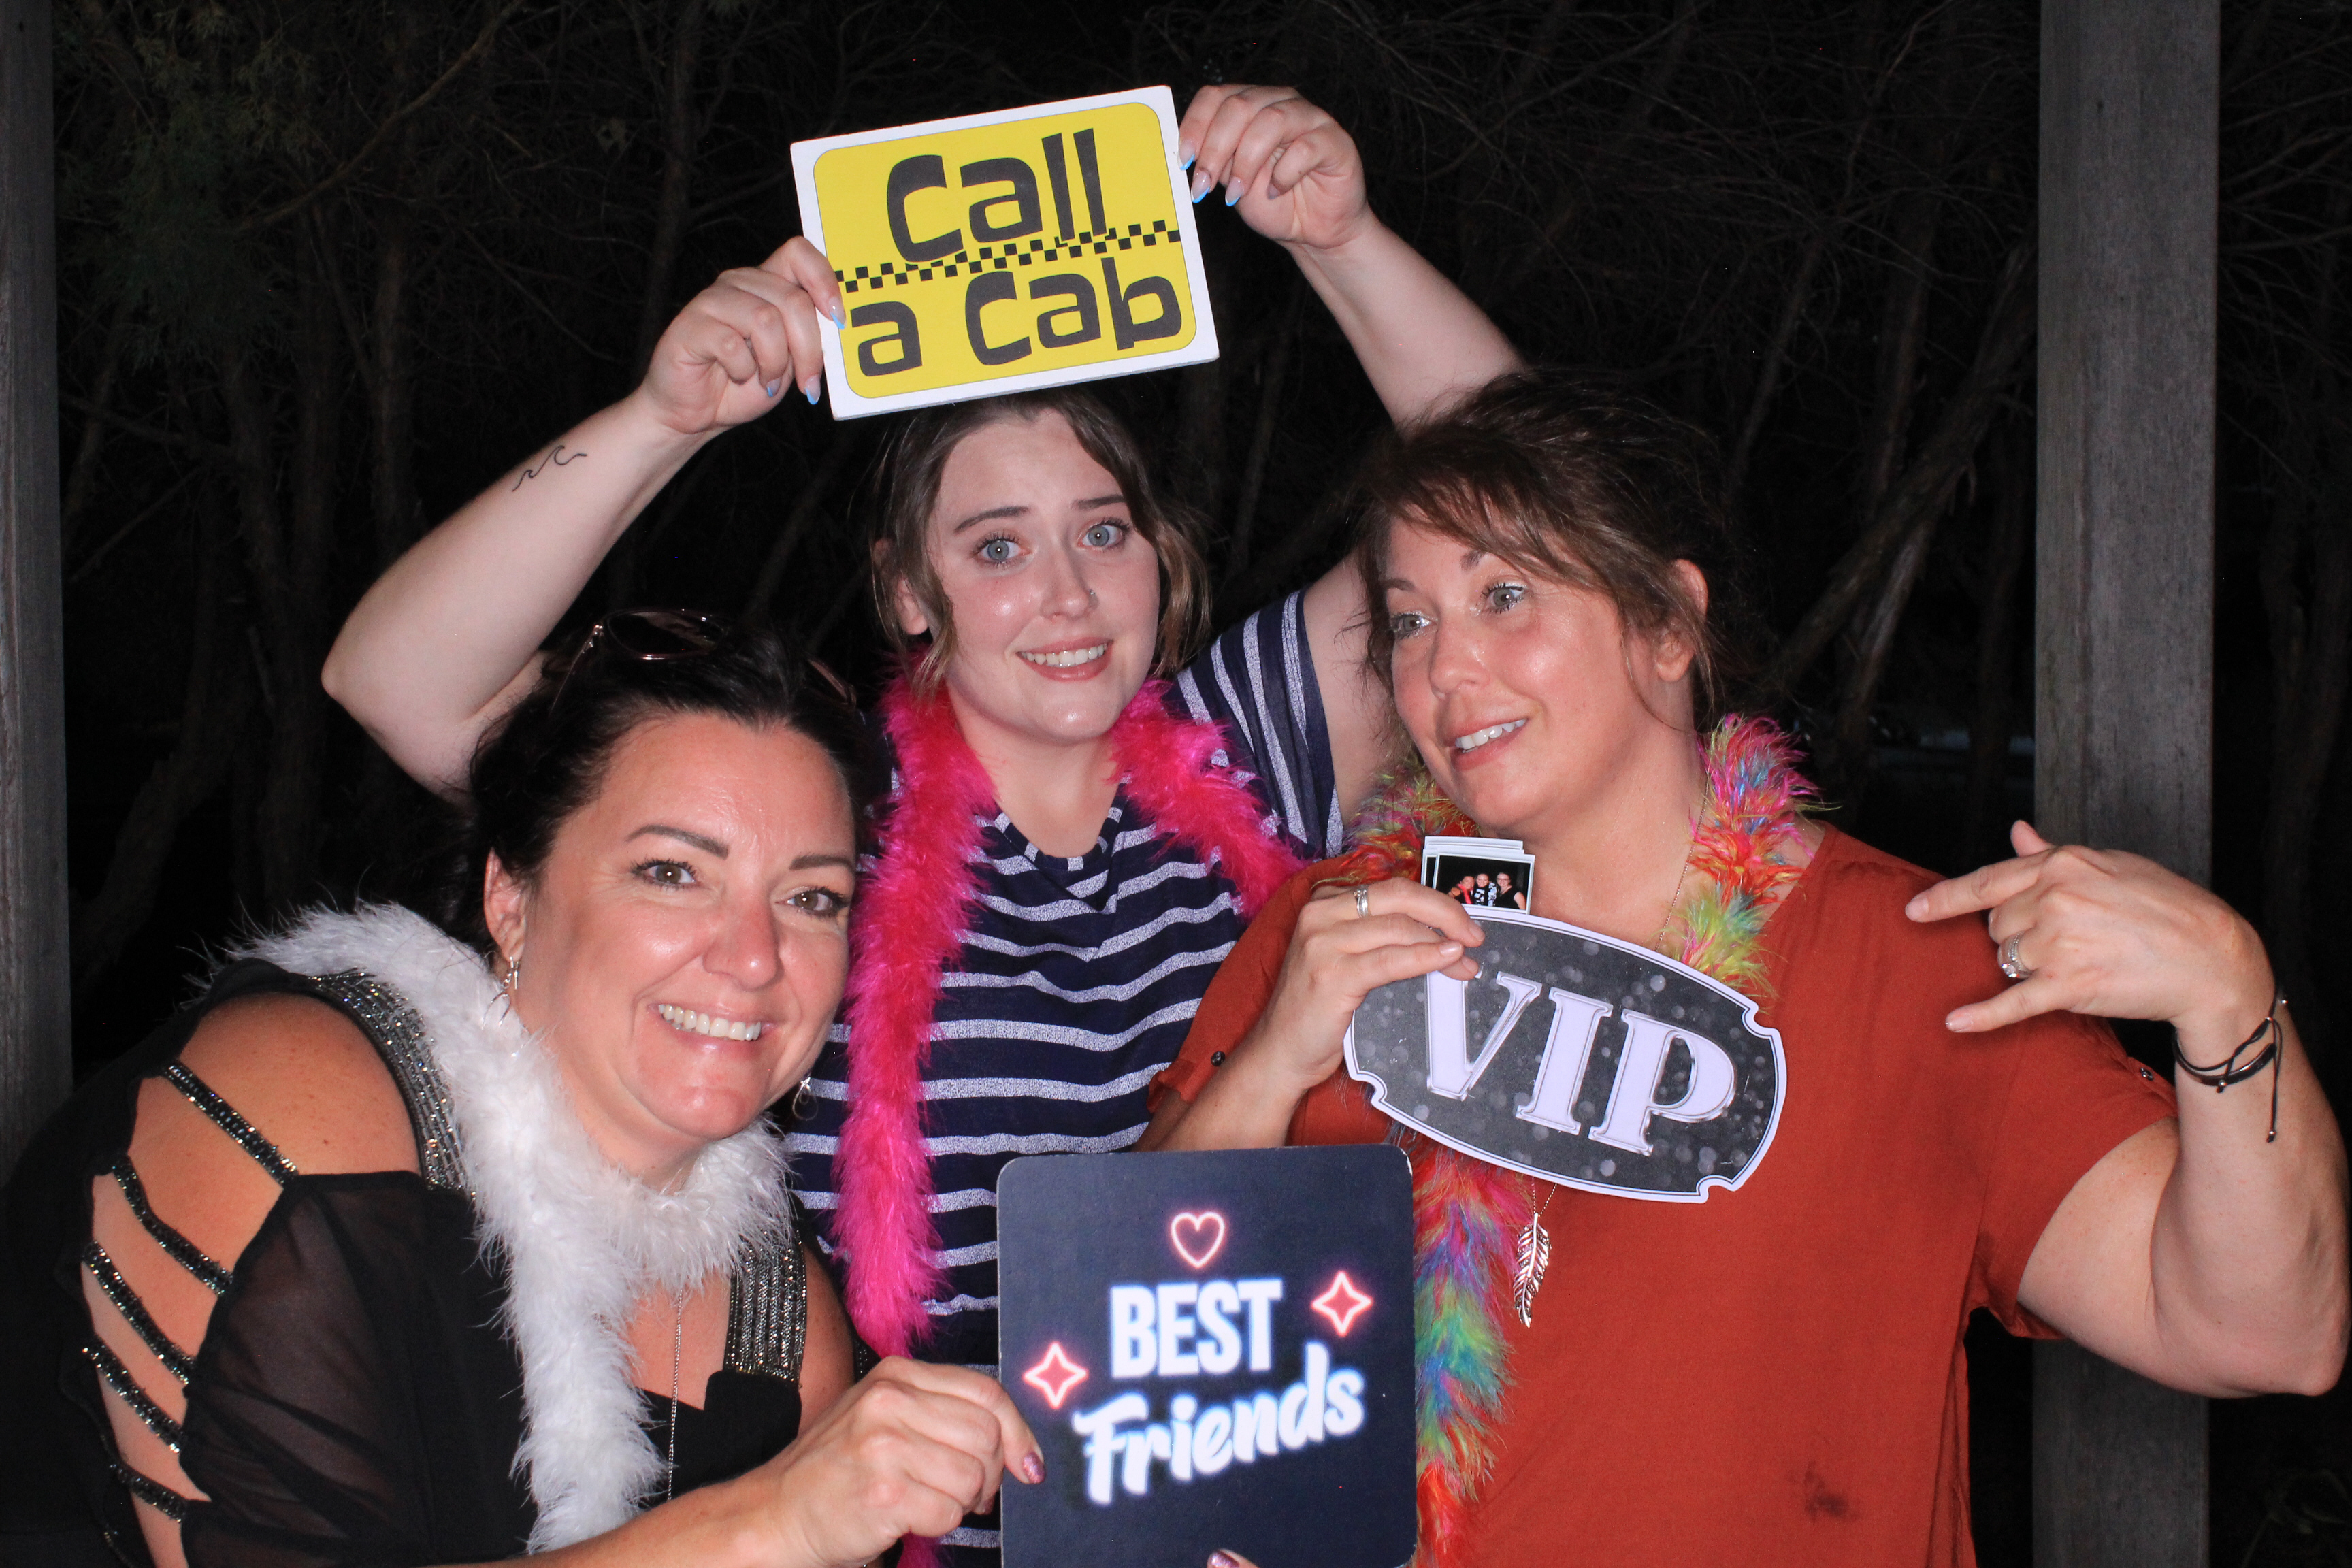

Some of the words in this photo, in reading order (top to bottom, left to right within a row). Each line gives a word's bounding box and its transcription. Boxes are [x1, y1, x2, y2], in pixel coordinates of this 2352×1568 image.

[887, 127, 1107, 263] Call
[850, 301, 923, 377] a
[965, 257, 1182, 365] Cab
[1425, 966, 1737, 1156] VIP
[1110, 1278, 1283, 1379] BEST
[1072, 1341, 1365, 1505] Friends
